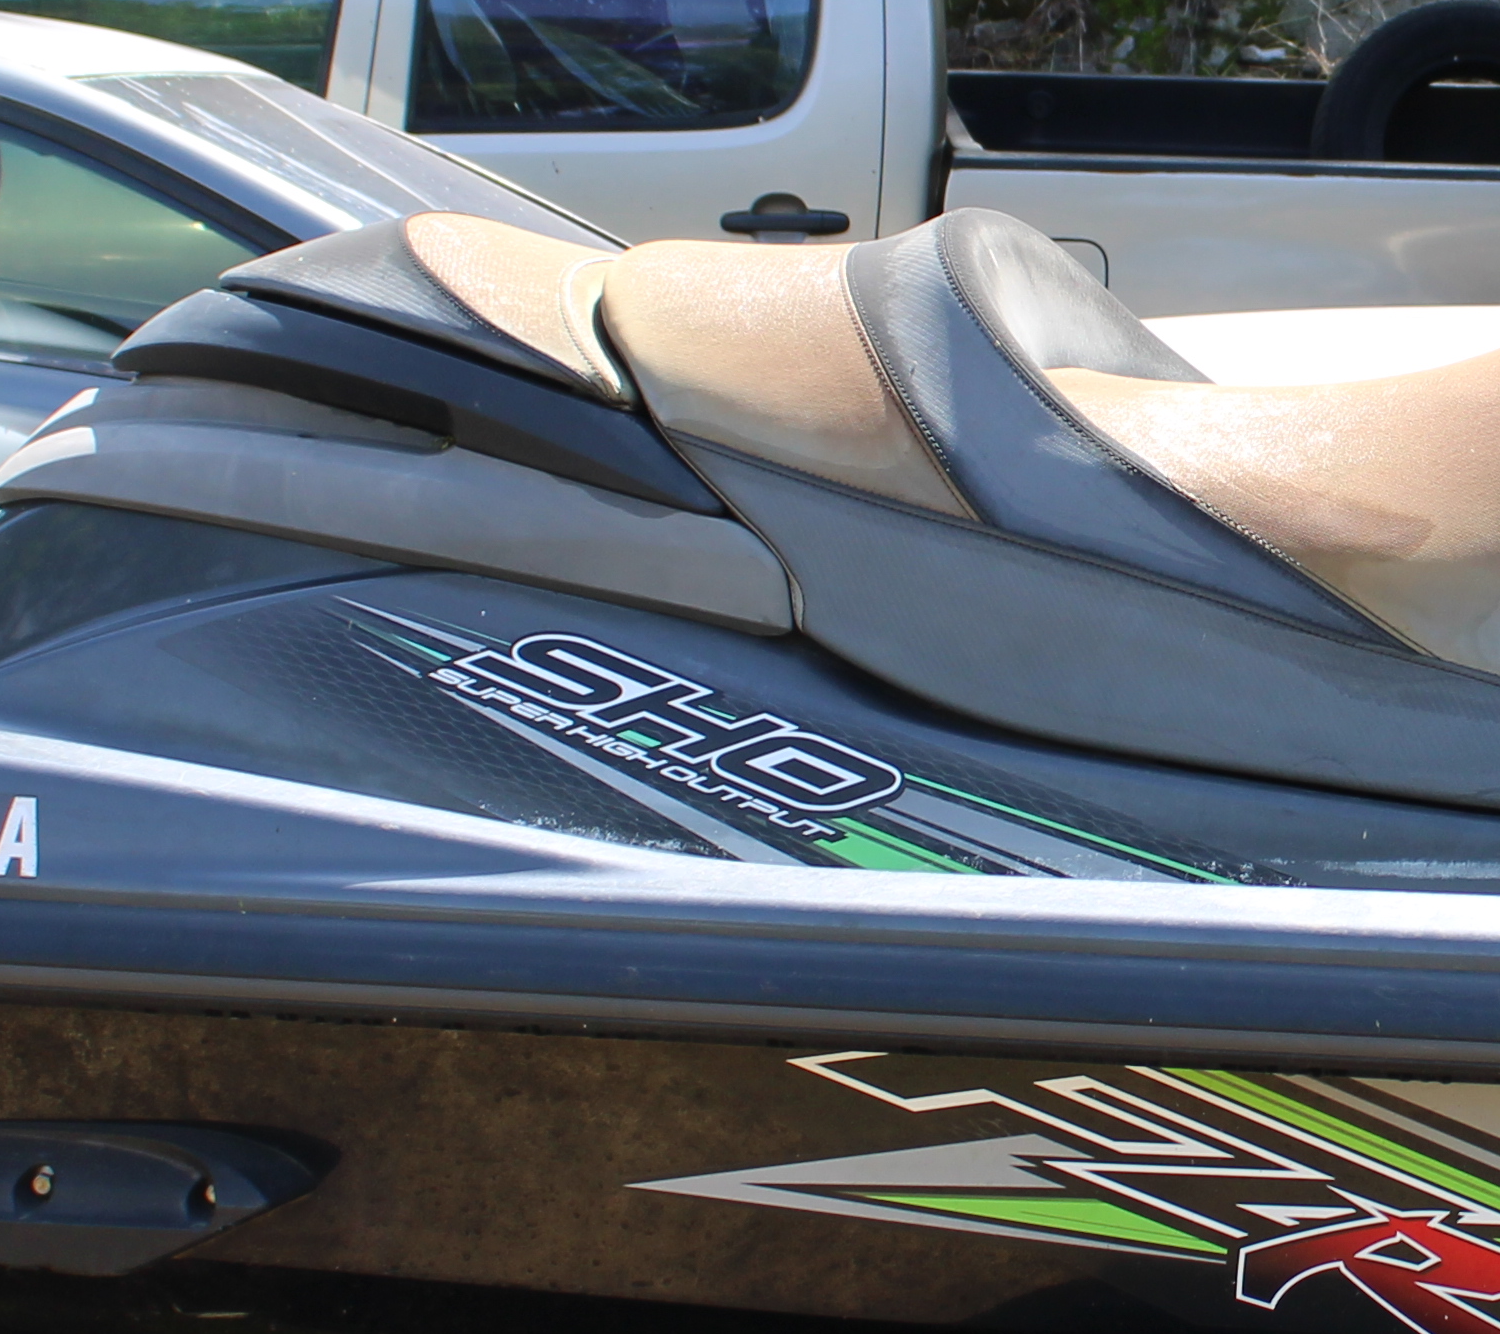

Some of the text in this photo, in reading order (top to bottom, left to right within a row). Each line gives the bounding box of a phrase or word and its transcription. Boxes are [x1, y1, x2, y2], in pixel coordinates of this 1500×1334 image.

[428, 667, 837, 837] SUPER HIGH OUTPUT
[453, 632, 902, 812] SHO
